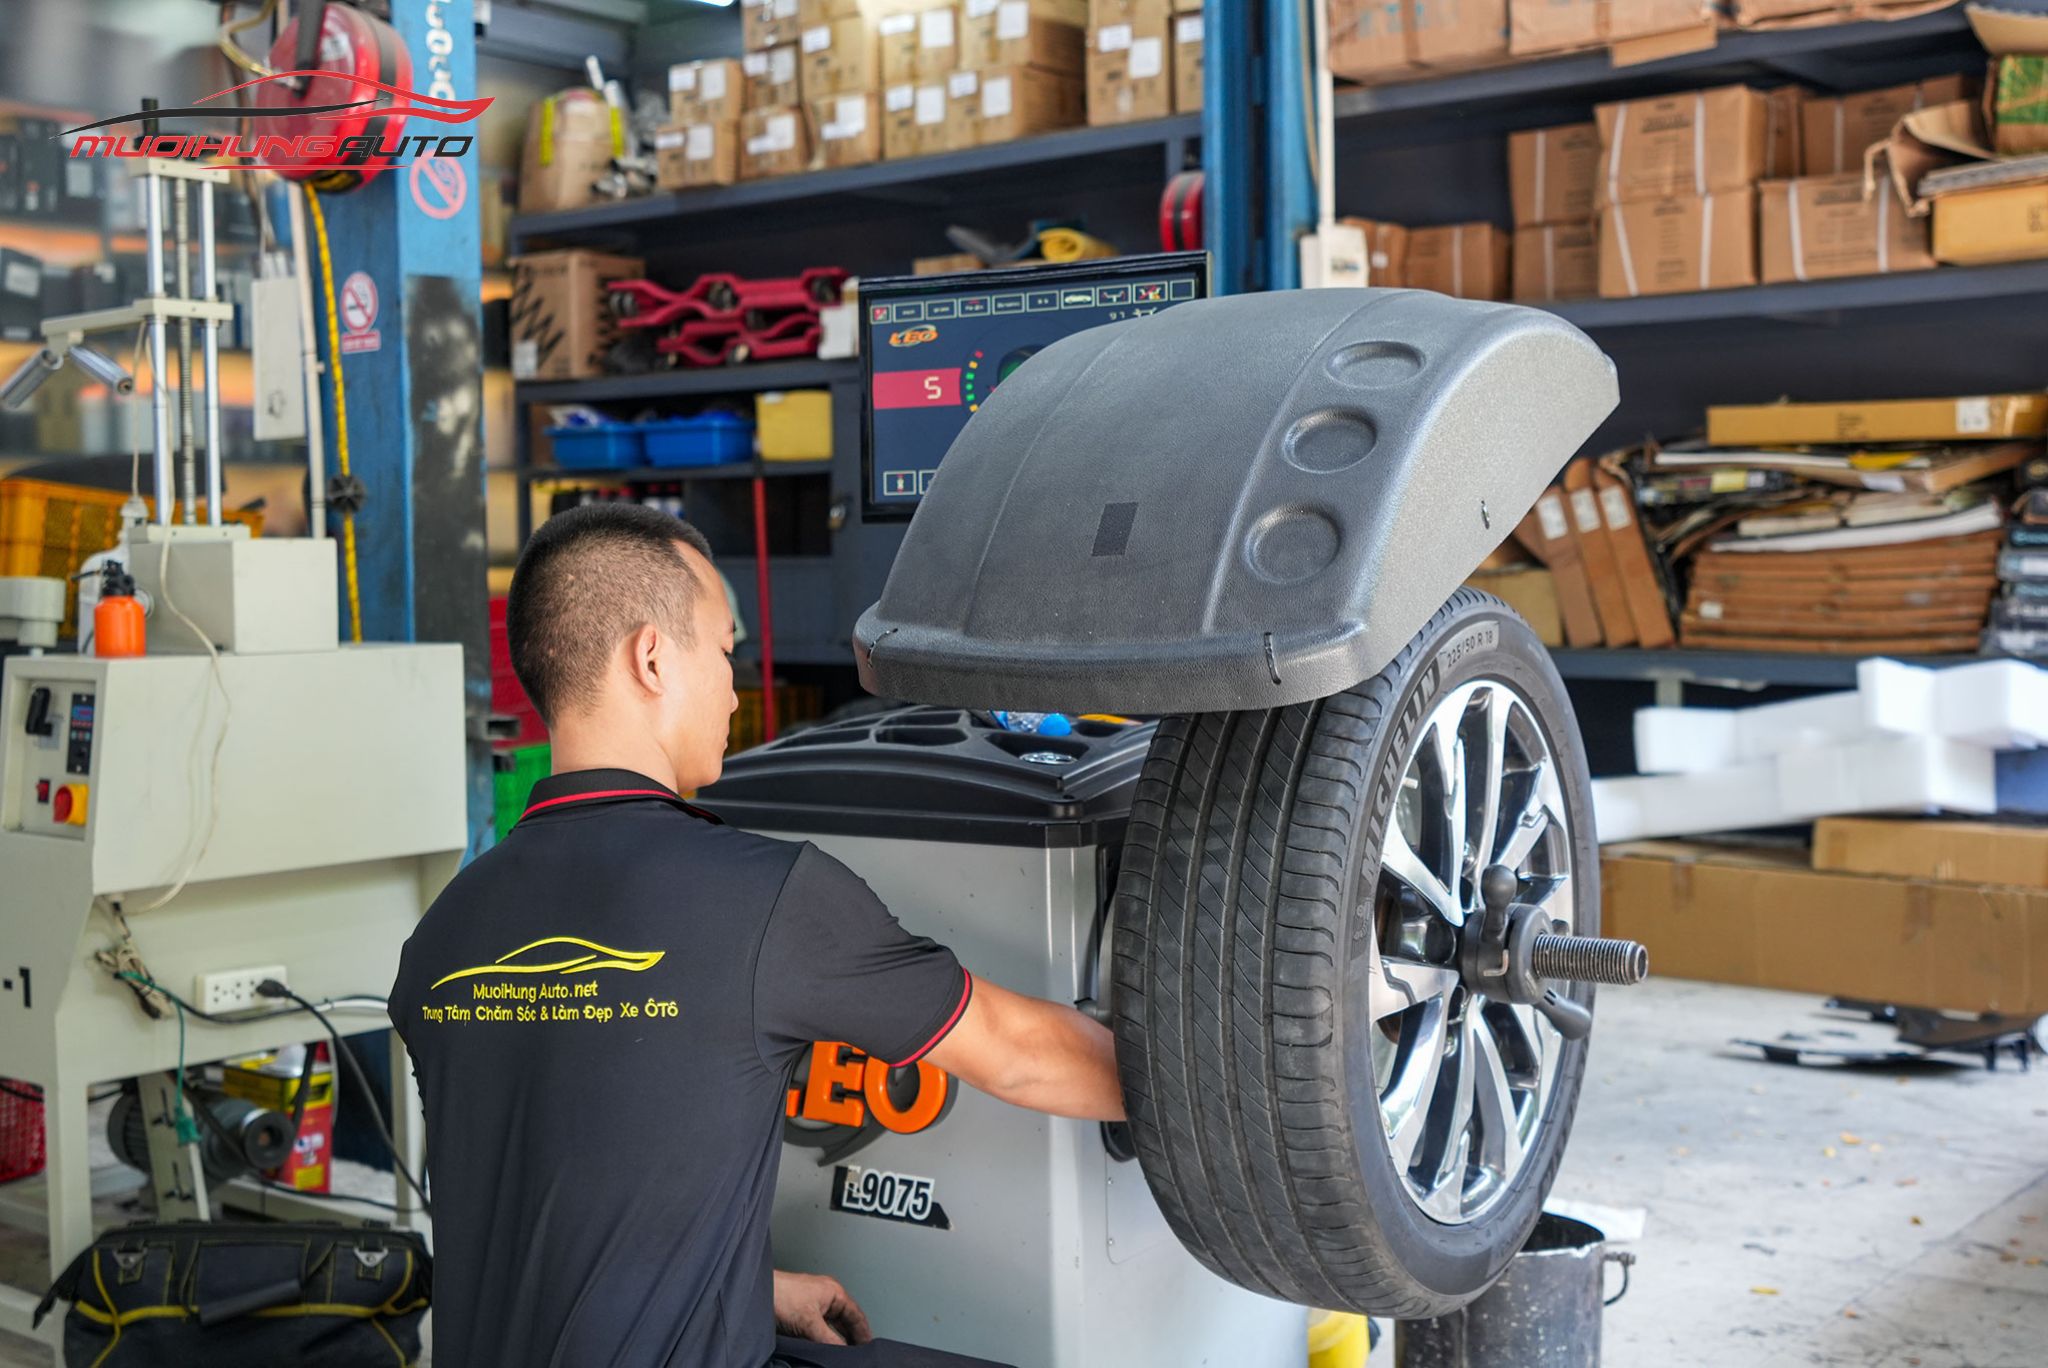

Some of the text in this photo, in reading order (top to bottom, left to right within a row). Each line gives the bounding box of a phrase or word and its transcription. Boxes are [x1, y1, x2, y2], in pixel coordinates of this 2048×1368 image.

[889, 329, 938, 345] LEO
[1361, 666, 1437, 883] MICHELIN
[473, 983, 537, 1003] MuoiHung
[422, 1006, 443, 1023] Trung
[445, 1004, 471, 1021] Tâm
[475, 1005, 513, 1021] Chăm
[516, 1005, 537, 1021] Sóc
[540, 1005, 549, 1021] &
[552, 1004, 579, 1021] Làm
[582, 1004, 613, 1023] Đẹp
[620, 1002, 639, 1018] Xe
[786, 1041, 947, 1133] EO
